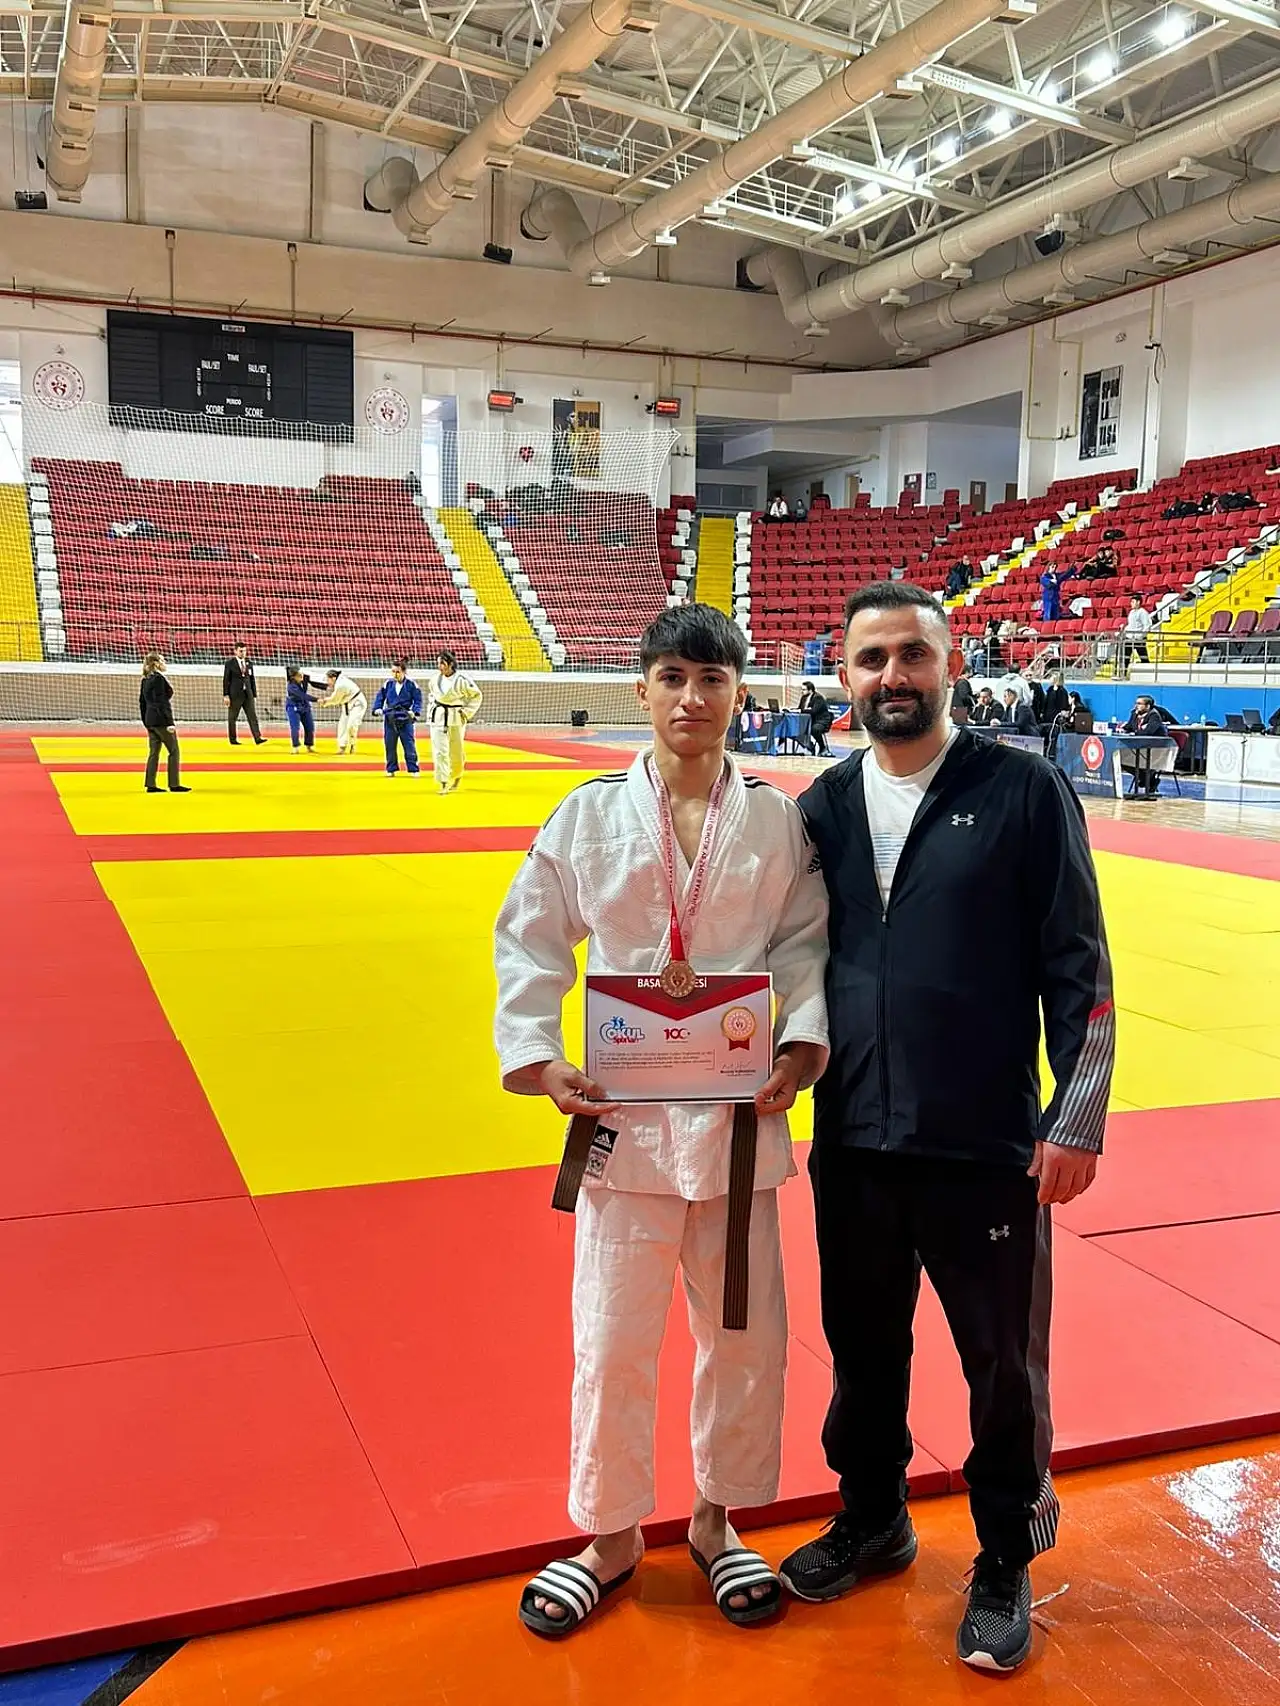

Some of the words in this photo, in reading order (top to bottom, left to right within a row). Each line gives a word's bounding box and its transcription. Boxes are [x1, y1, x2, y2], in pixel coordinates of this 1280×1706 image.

[205, 405, 225, 416] SCORE
[244, 407, 265, 418] SCORE
[637, 977, 661, 990] BAŞA
